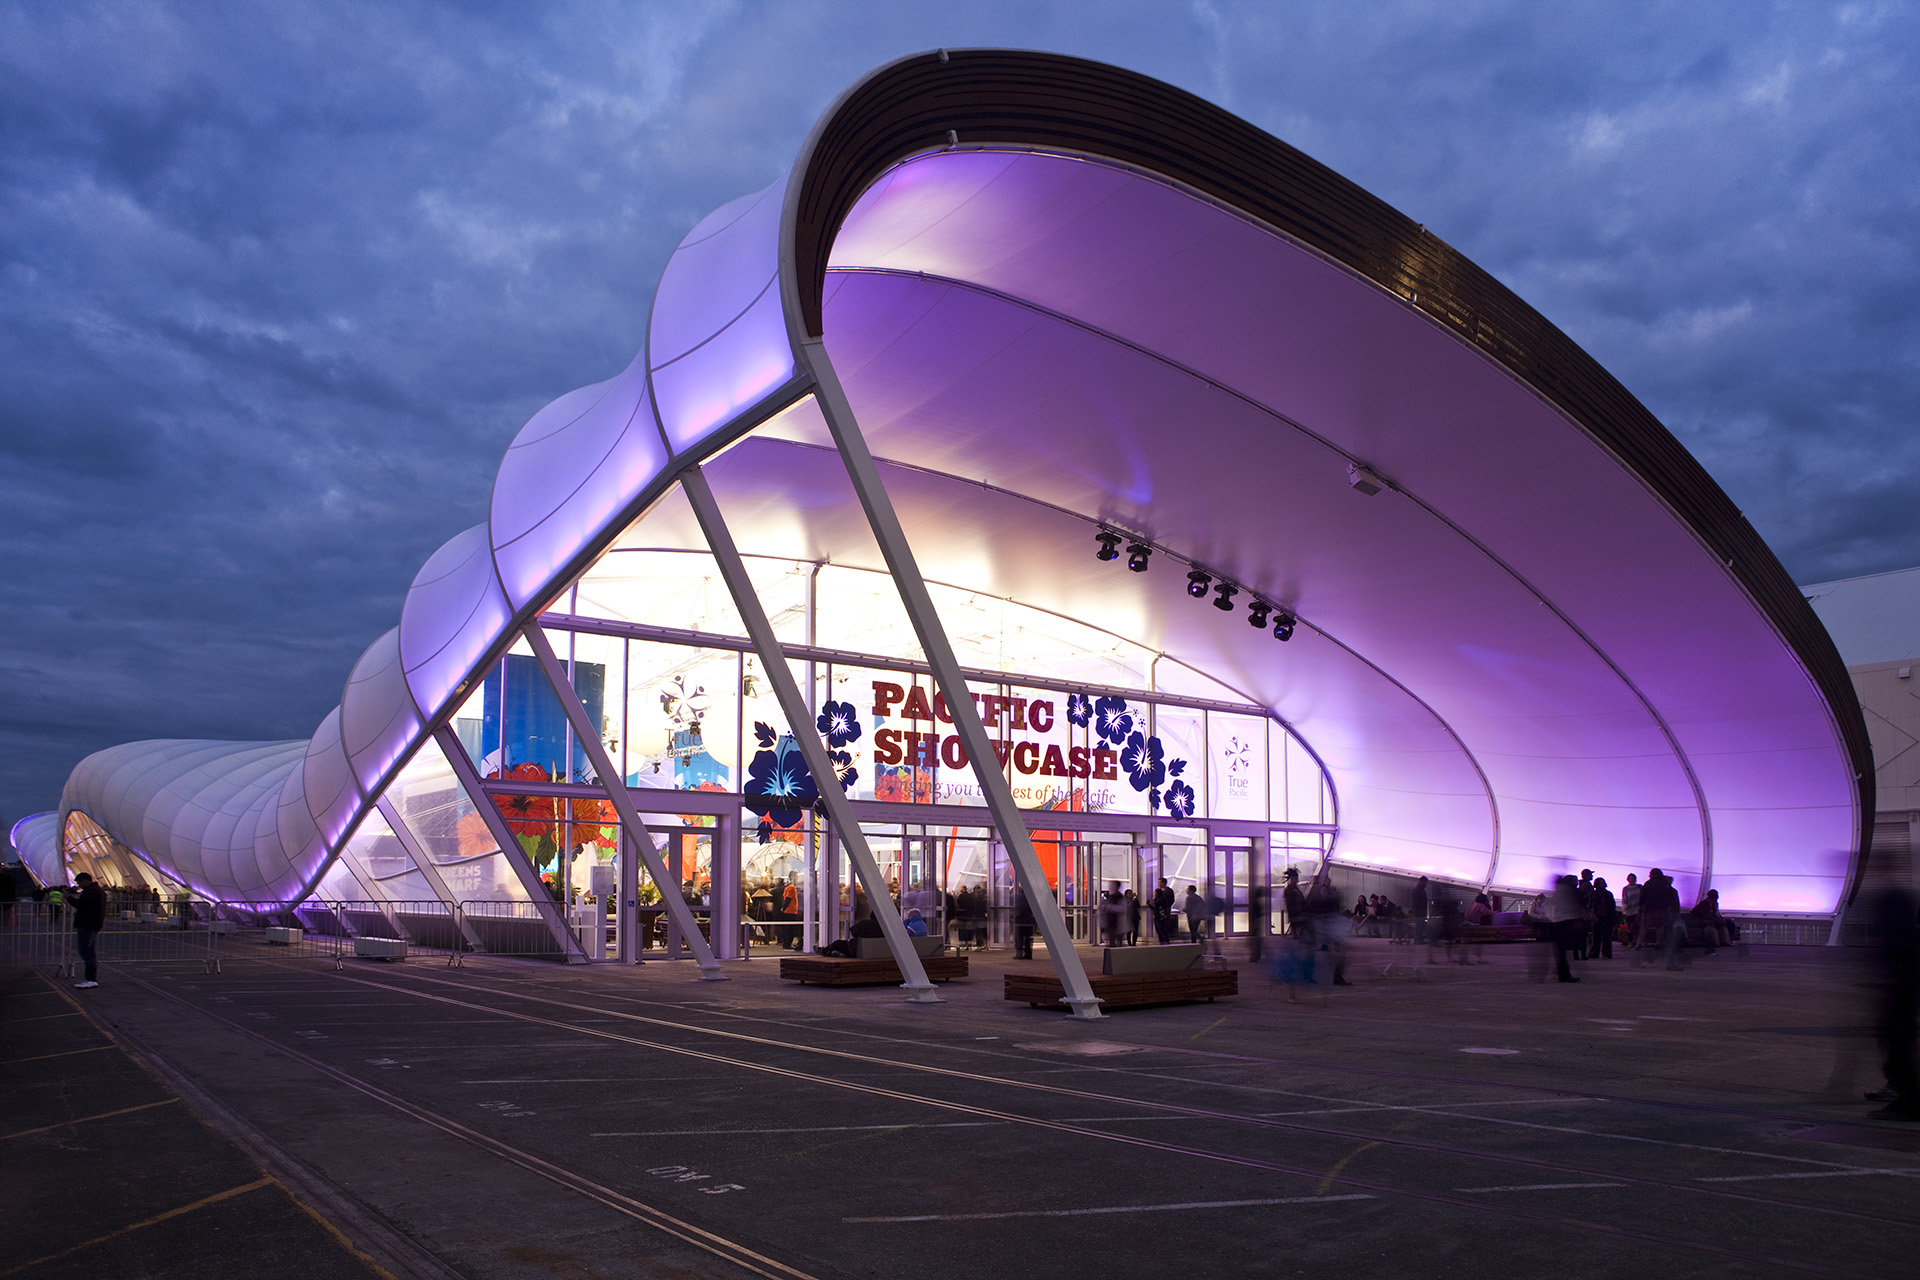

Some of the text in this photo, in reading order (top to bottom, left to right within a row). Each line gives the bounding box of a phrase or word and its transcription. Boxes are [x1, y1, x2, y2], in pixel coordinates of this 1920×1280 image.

[872, 681, 1054, 733] PACFIC
[874, 776, 942, 799] Bringing
[943, 783, 973, 799] you
[1012, 785, 1033, 800] est
[1035, 784, 1051, 804] of
[1051, 785, 1071, 802] the
[1073, 785, 1116, 805] Pacific
[1228, 774, 1249, 788] True
[446, 878, 482, 892] HARF
